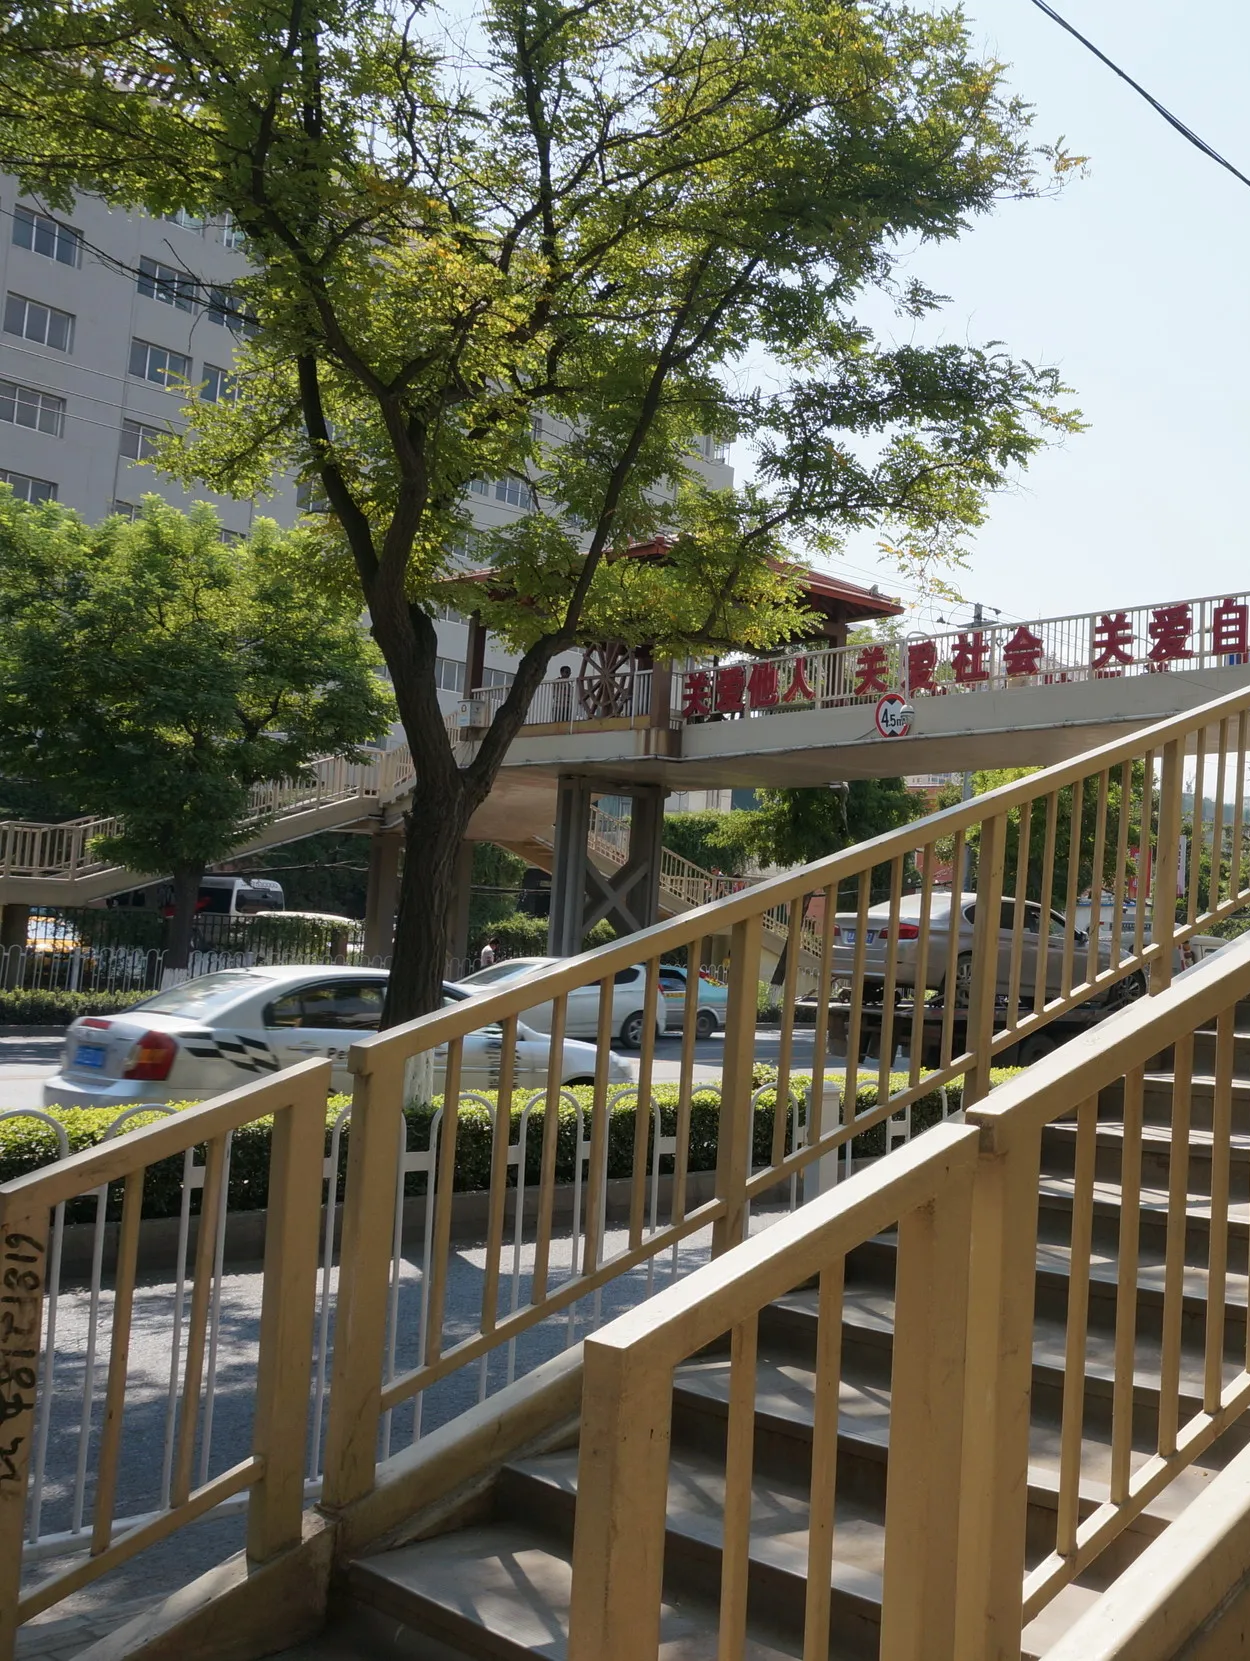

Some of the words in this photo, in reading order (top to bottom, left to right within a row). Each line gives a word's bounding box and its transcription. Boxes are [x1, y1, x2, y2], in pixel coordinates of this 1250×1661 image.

[682, 656, 816, 718] 关爱他人
[853, 625, 1044, 699] 关爱社会
